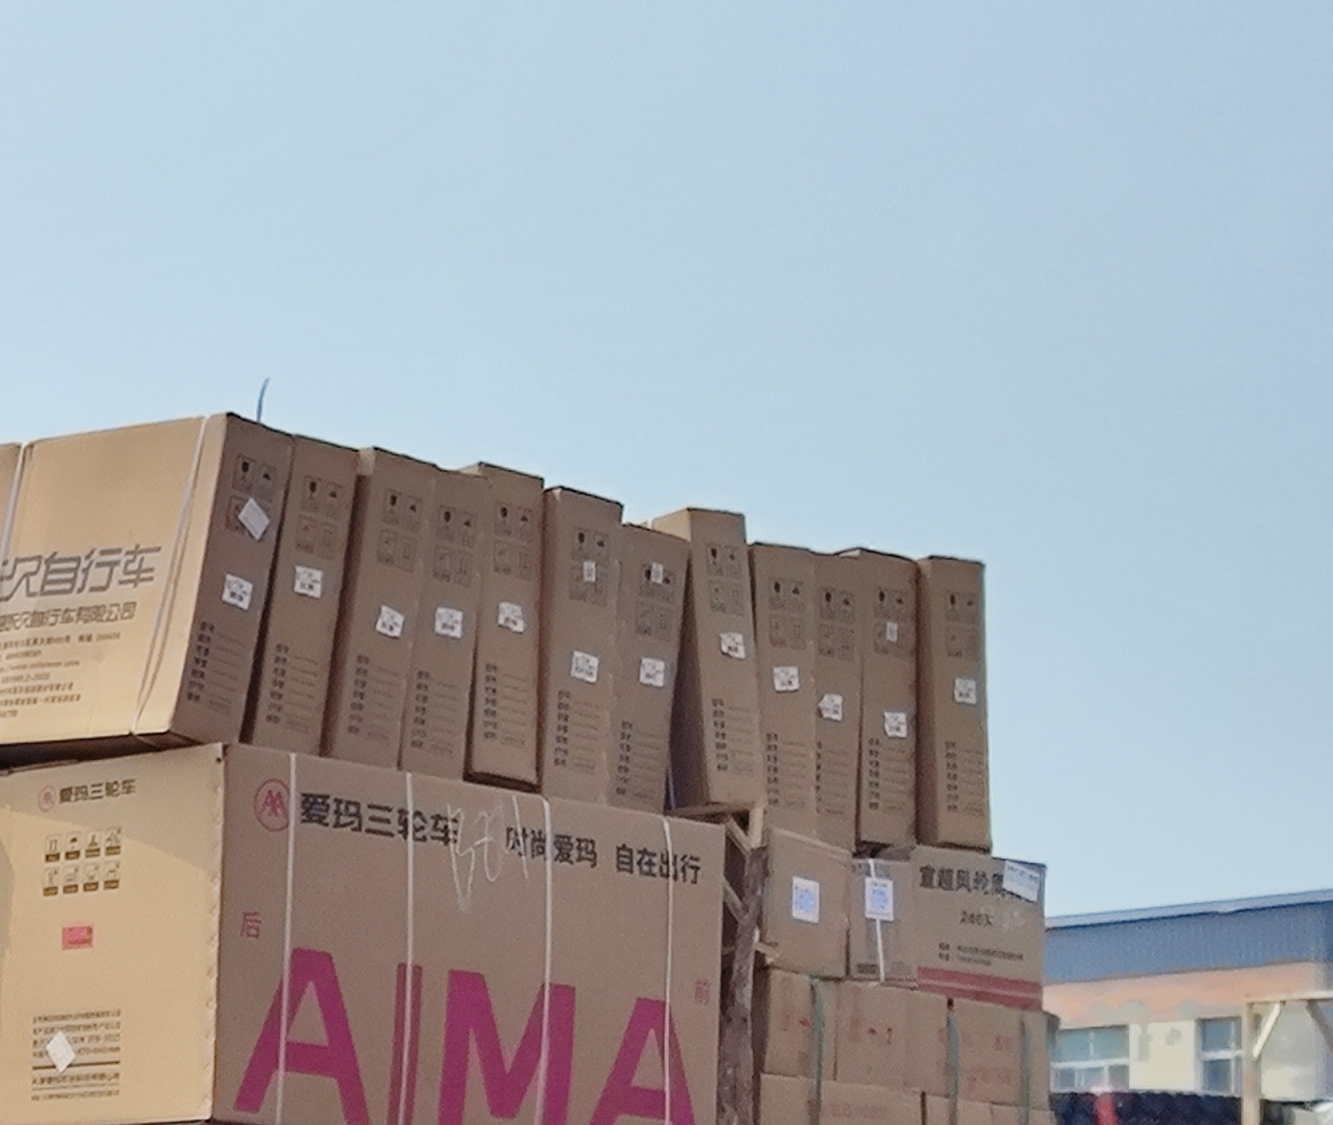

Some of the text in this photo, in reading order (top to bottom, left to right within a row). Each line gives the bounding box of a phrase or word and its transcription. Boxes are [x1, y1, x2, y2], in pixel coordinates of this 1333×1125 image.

[59, 779, 136, 804] 爱玛三轮车
[299, 792, 459, 846] 爱玛三轮车
[506, 826, 702, 885] 时尚爱玛 自在出行
